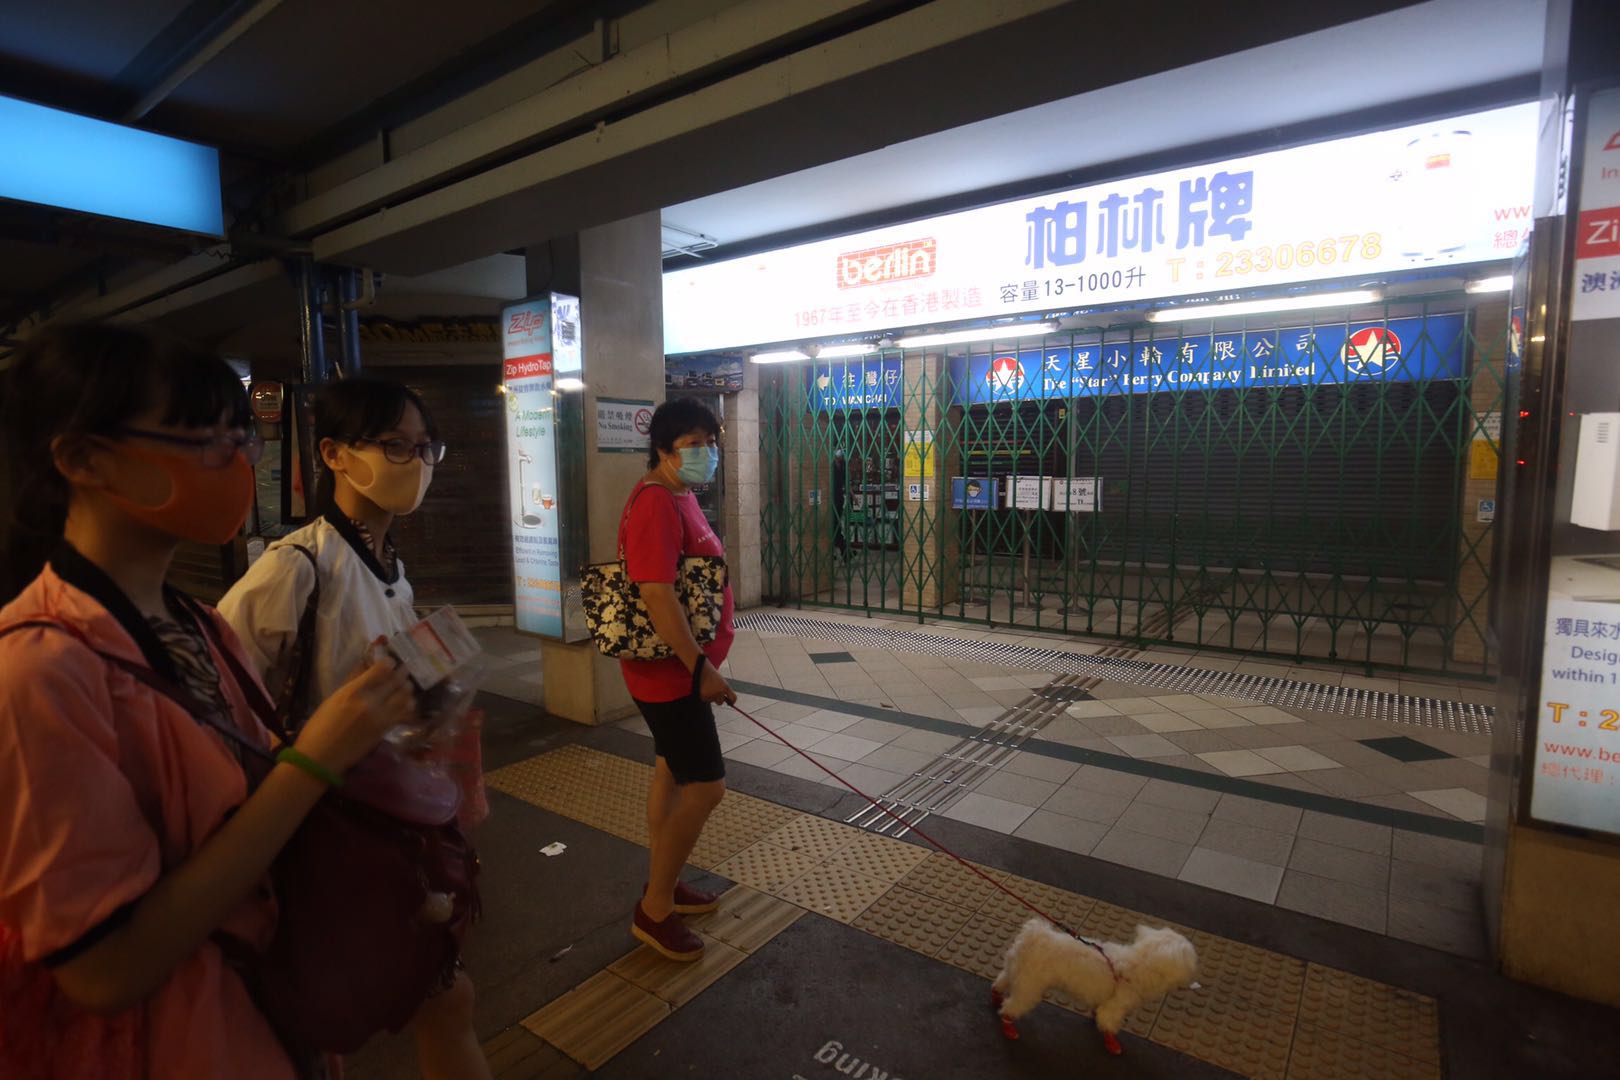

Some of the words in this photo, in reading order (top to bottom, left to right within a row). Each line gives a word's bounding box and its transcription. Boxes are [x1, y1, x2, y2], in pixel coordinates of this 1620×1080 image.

[1025, 171, 1254, 269] 柏林牌
[1494, 205, 1534, 221] ww
[1586, 219, 1620, 245] Zi
[842, 247, 930, 286] berlin
[1215, 232, 1382, 278] 23306678
[508, 311, 545, 336] Zip
[506, 364, 518, 376] Zip
[1123, 373, 1163, 387] Ferry
[1167, 370, 1242, 384] Company
[1250, 362, 1315, 378] Limited
[608, 422, 632, 432] Smoking
[1571, 646, 1620, 666] Desig
[1552, 668, 1605, 684] within
[1598, 709, 1620, 731] 2
